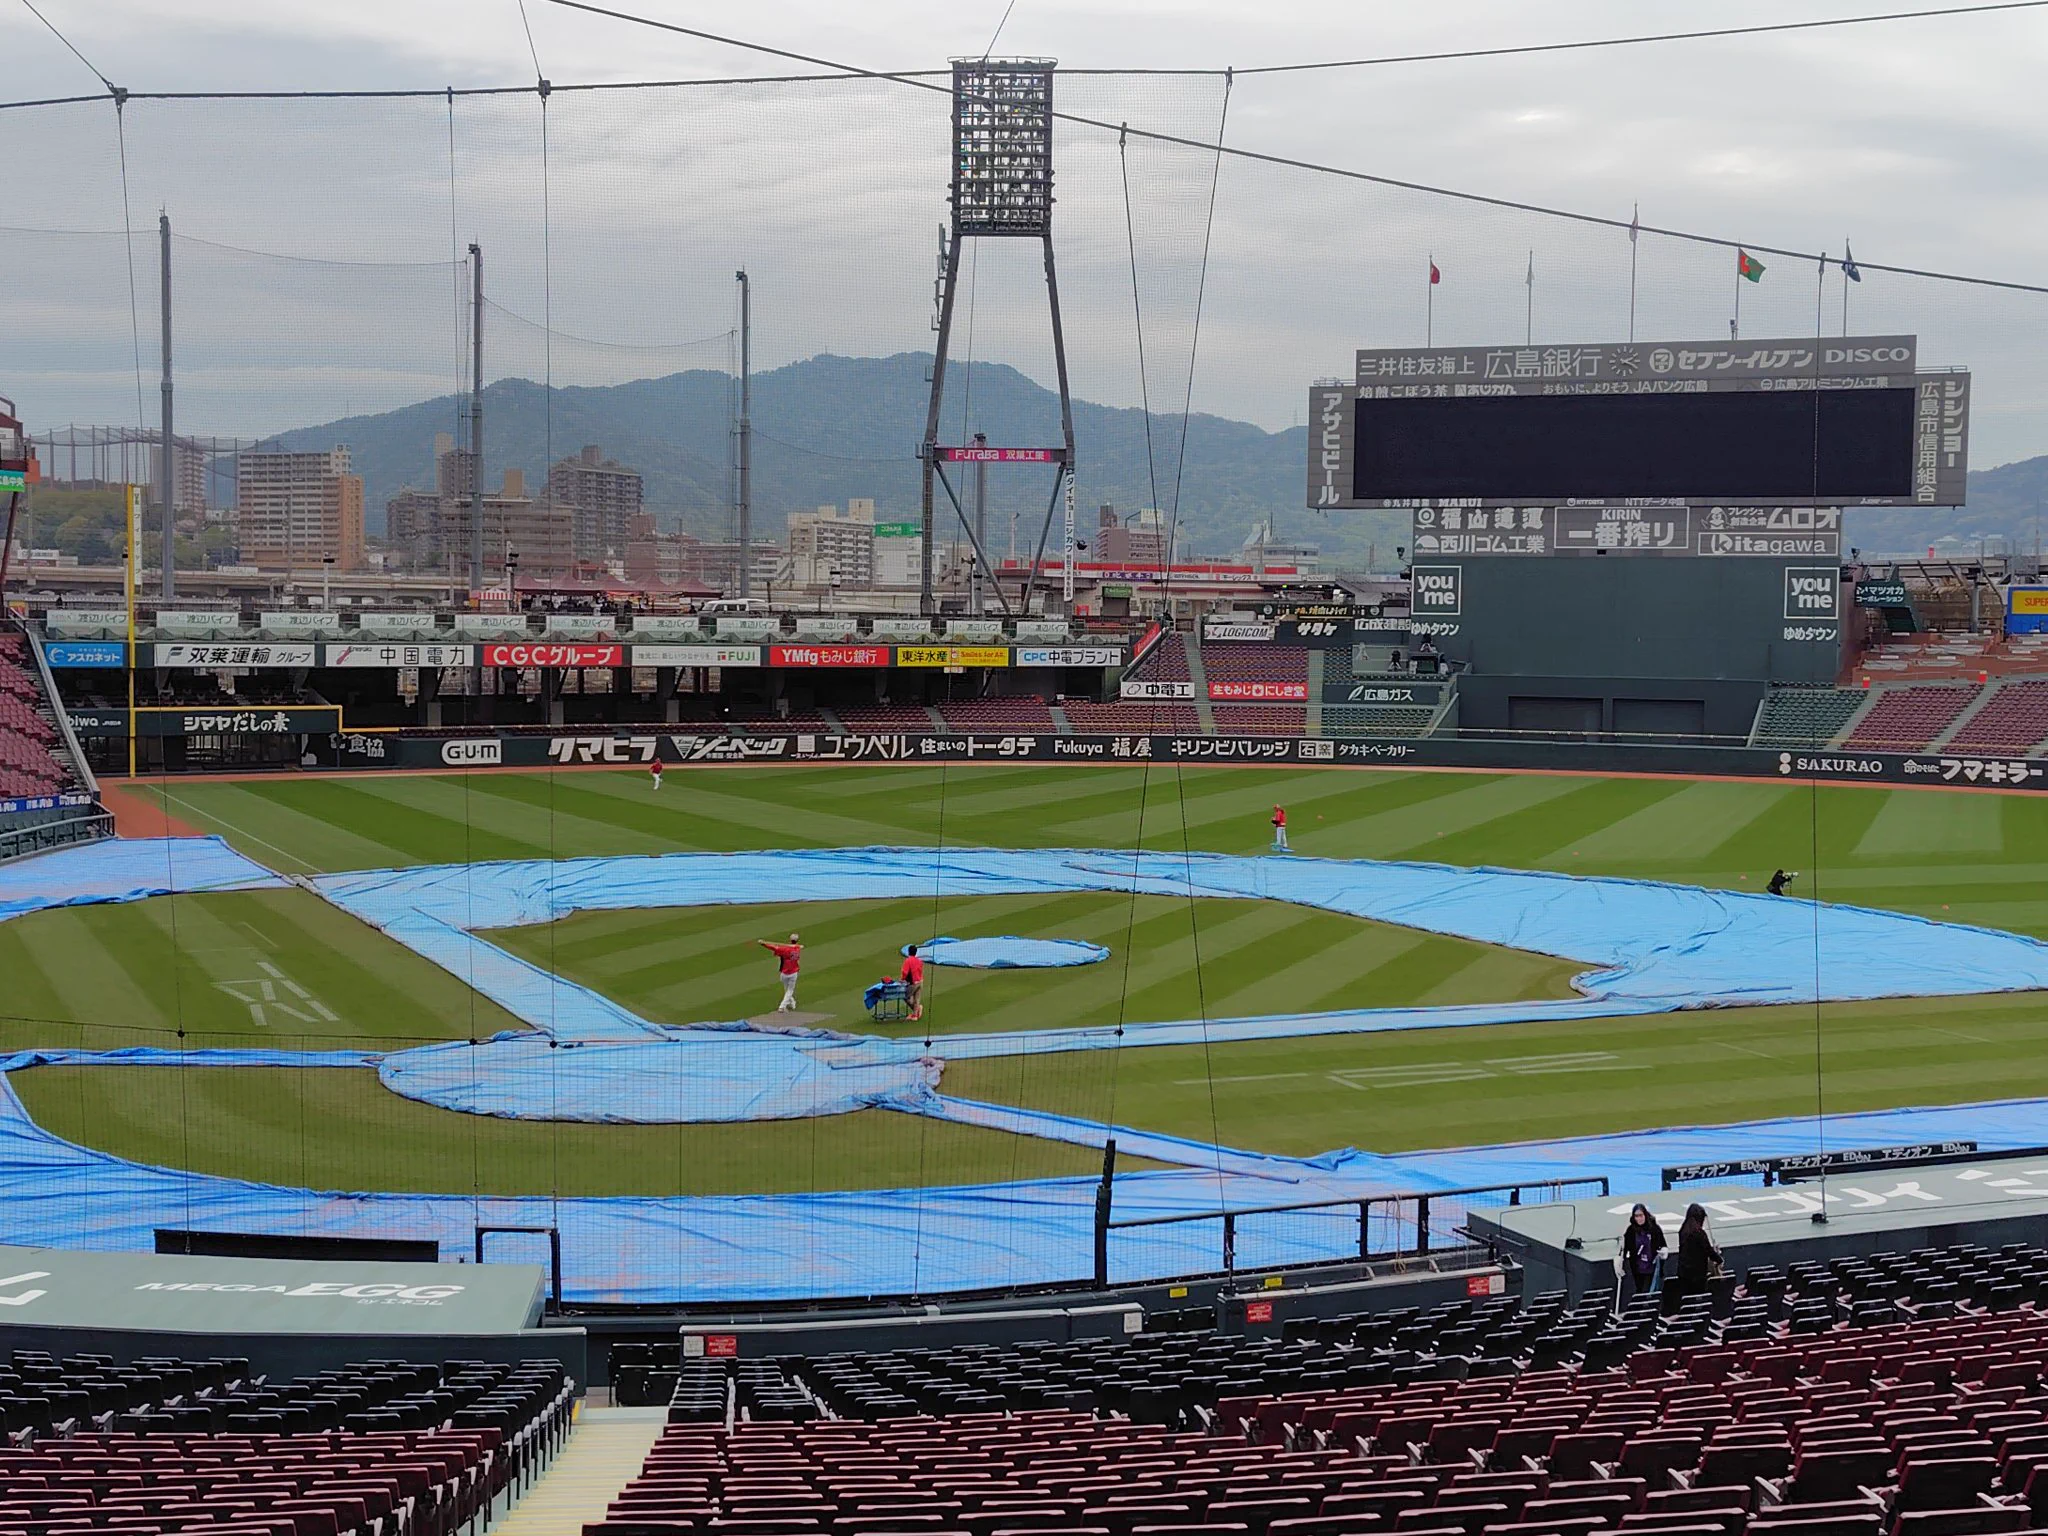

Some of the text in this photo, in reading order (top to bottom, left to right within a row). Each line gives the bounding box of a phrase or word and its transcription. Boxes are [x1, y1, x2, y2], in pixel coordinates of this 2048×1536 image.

[1824, 348, 1910, 363] DISCO
[1358, 356, 1475, 377] 三井住友海上
[1484, 349, 1603, 379] 広島銀行
[1633, 380, 1708, 393] JAバンク広島
[1775, 376, 1888, 390] 広島アルミニウム工業
[1359, 385, 1448, 398] 焙煎ごぼう茶
[1943, 380, 1965, 468] シシンヨー
[1319, 393, 1343, 505] アサヒビール
[1916, 381, 1940, 503] 広島市信用組合
[1438, 498, 1483, 508] MARUI
[1601, 509, 1641, 520] KIRIN
[1766, 507, 1841, 529] ムロオ
[1568, 521, 1675, 547] 一番搾り
[1440, 535, 1545, 553] 西川ゴム工業
[1417, 574, 1454, 592] you
[1791, 577, 1831, 596] you
[1868, 586, 1905, 595] マツオカ
[1423, 590, 1456, 605] me
[1798, 592, 1833, 609] me
[1222, 627, 1268, 638] LOGICOM
[1297, 622, 1338, 636] サタケ
[1410, 622, 1460, 636] ゆめタウン
[1784, 627, 1837, 641] ゆめタウン
[67, 652, 121, 662] アスカネット
[187, 647, 312, 663] 双葉運輸 グループ
[380, 646, 465, 665] 中国電力
[493, 646, 614, 665] CGCグループ
[728, 651, 756, 661] FUJI
[820, 649, 877, 665] もみじ銀行
[1023, 652, 1047, 662] CPC
[1049, 651, 1121, 665] 中電プラント
[1146, 683, 1190, 697] 中電工
[1213, 684, 1251, 696] 生もみじ
[1364, 688, 1413, 701] 広島ガス
[184, 712, 290, 732] シマヤだしの素
[548, 737, 657, 762] クマヒラ
[689, 735, 788, 760] ジーベック
[824, 735, 914, 759] ユウベル
[1054, 740, 1104, 756] Fukuya
[1111, 737, 1153, 757] 福屋
[1171, 739, 1291, 756] キリンビバレッジ
[1338, 743, 1416, 757] タカキベーカリー
[1796, 758, 1883, 773] SAKURAO
[1940, 759, 2044, 784] フマキラー
[1881, 1145, 1933, 1160] エディオン
[1780, 1155, 1834, 1170] エディオン
[1676, 1164, 1731, 1182] エディオン
[134, 1282, 466, 1299] MEGA EGG
